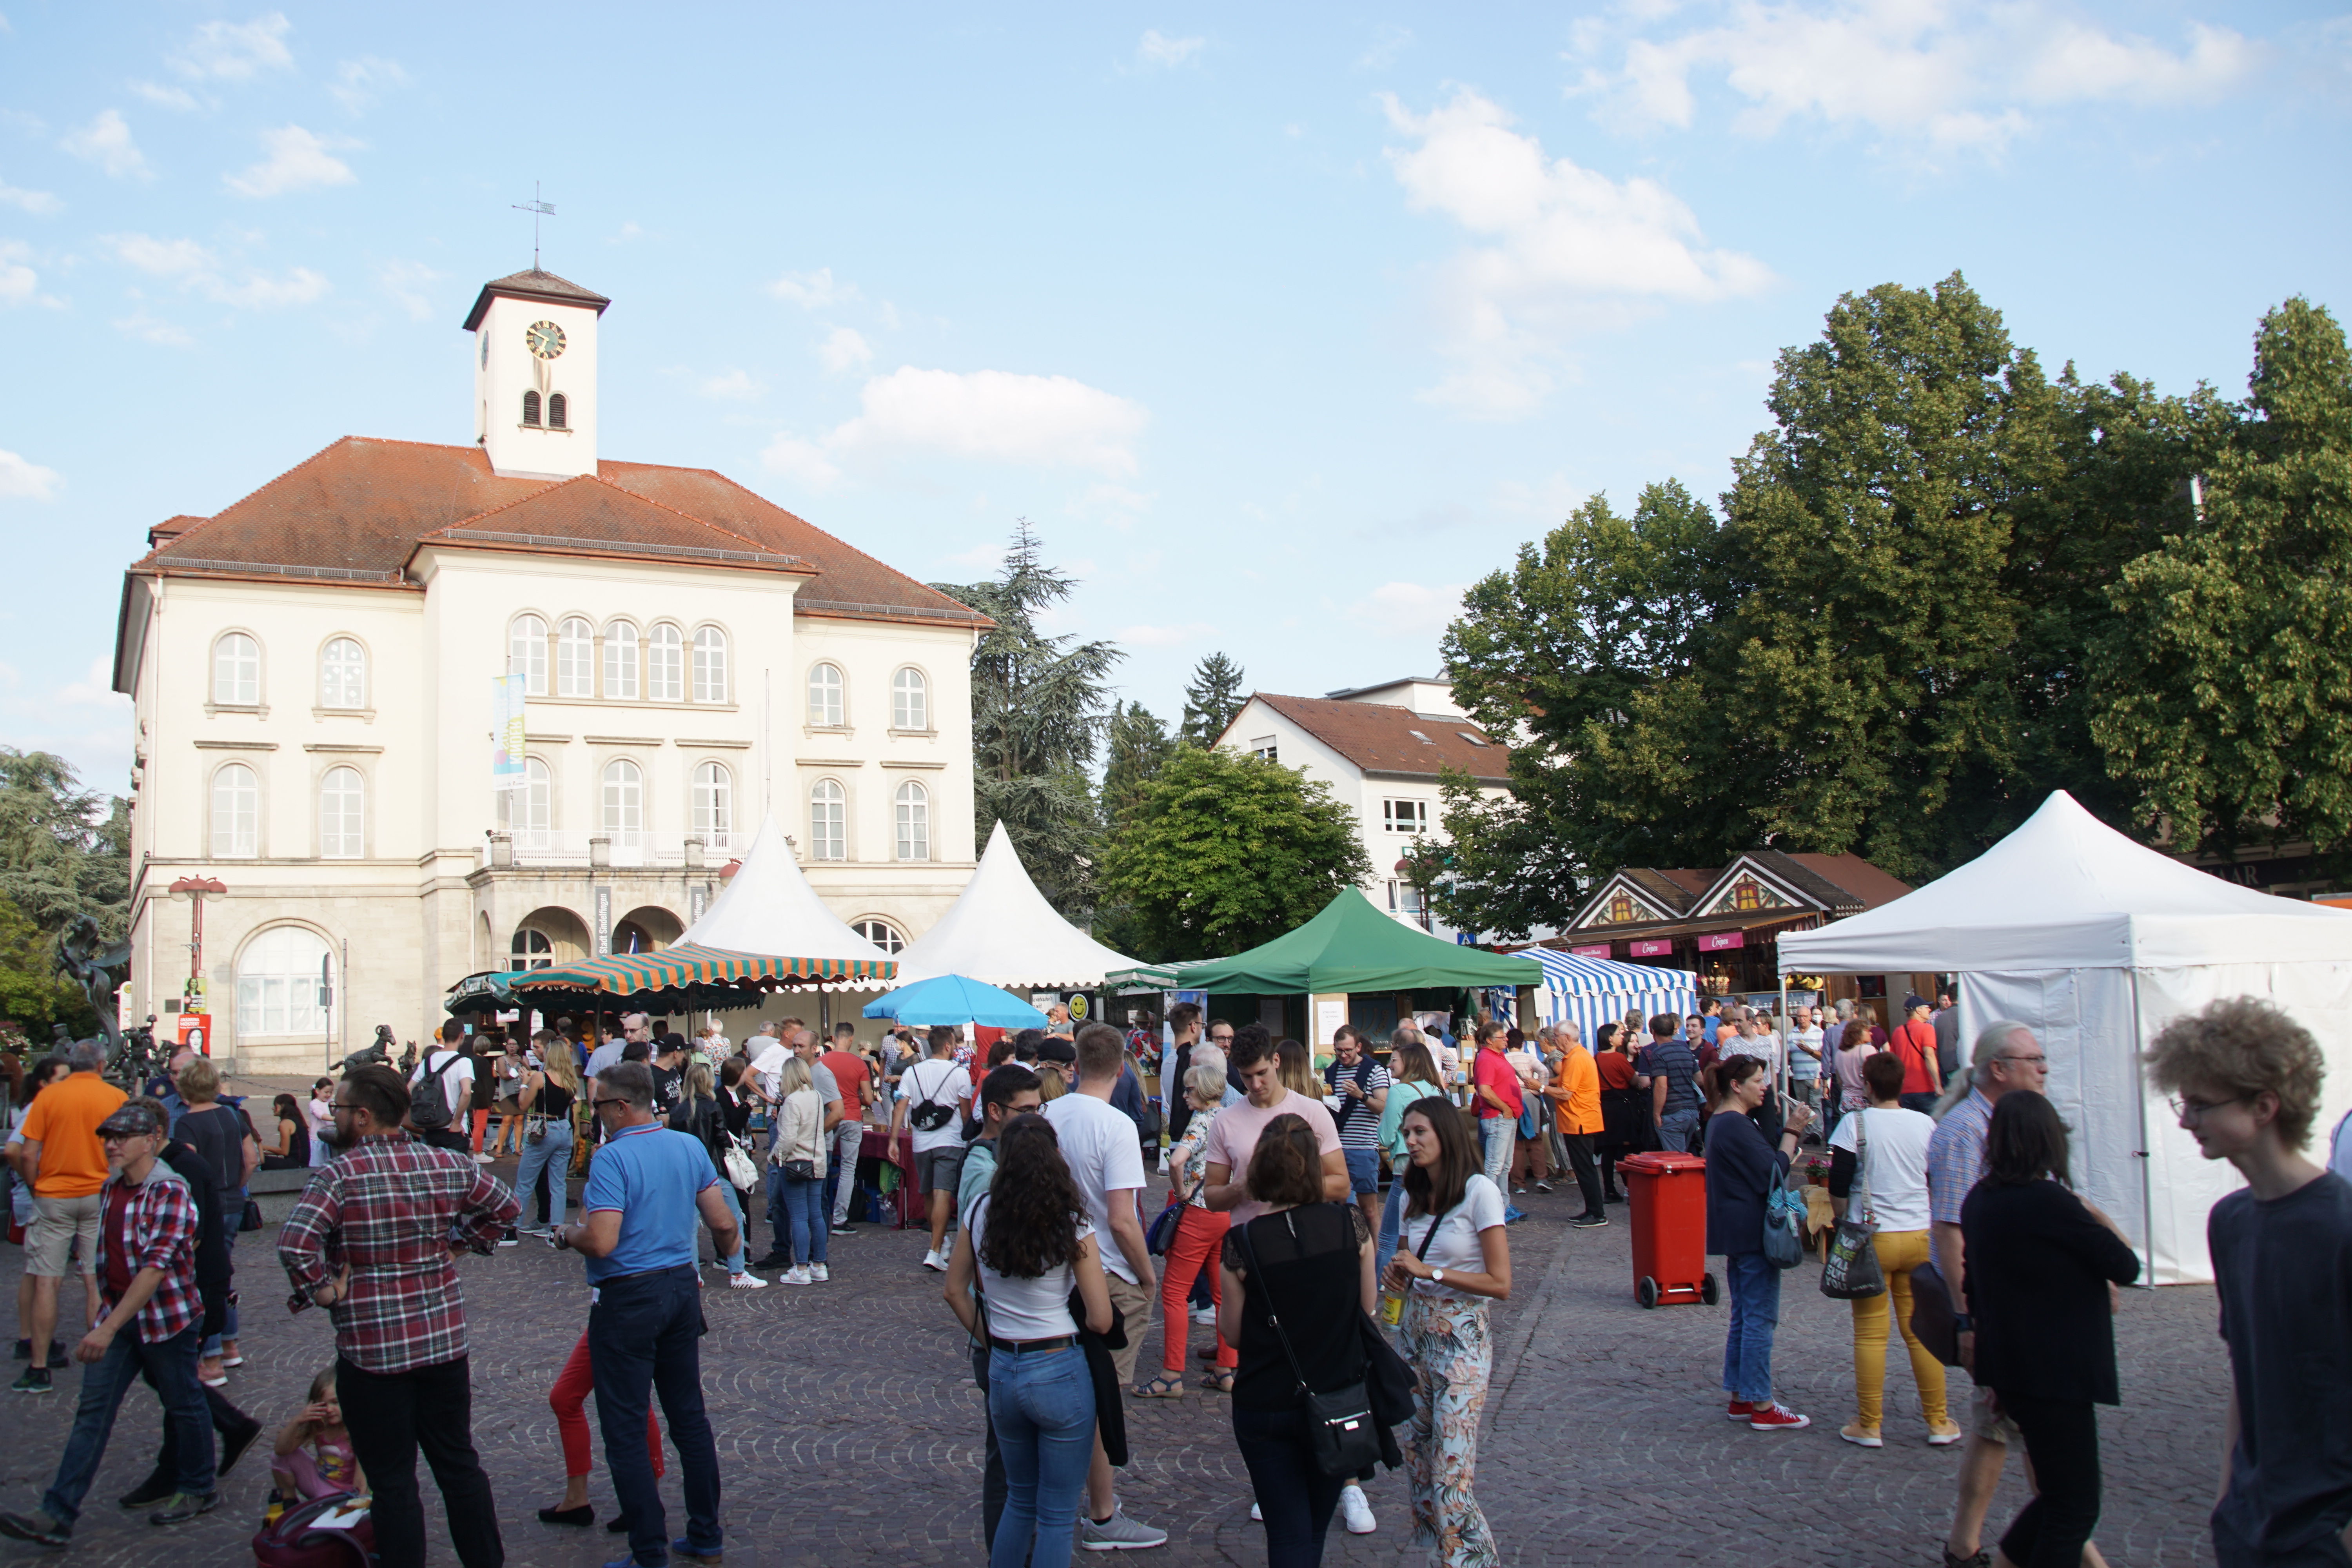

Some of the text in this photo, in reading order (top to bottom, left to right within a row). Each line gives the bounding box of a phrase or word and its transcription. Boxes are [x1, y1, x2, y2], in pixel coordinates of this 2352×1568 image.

[598, 893, 609, 934] Sindelfingen
[599, 935, 608, 954] Stadt
[1642, 943, 1658, 954] Crêpes
[1711, 936, 1729, 948] Crêpes
[1825, 1274, 1848, 1291] YOU
